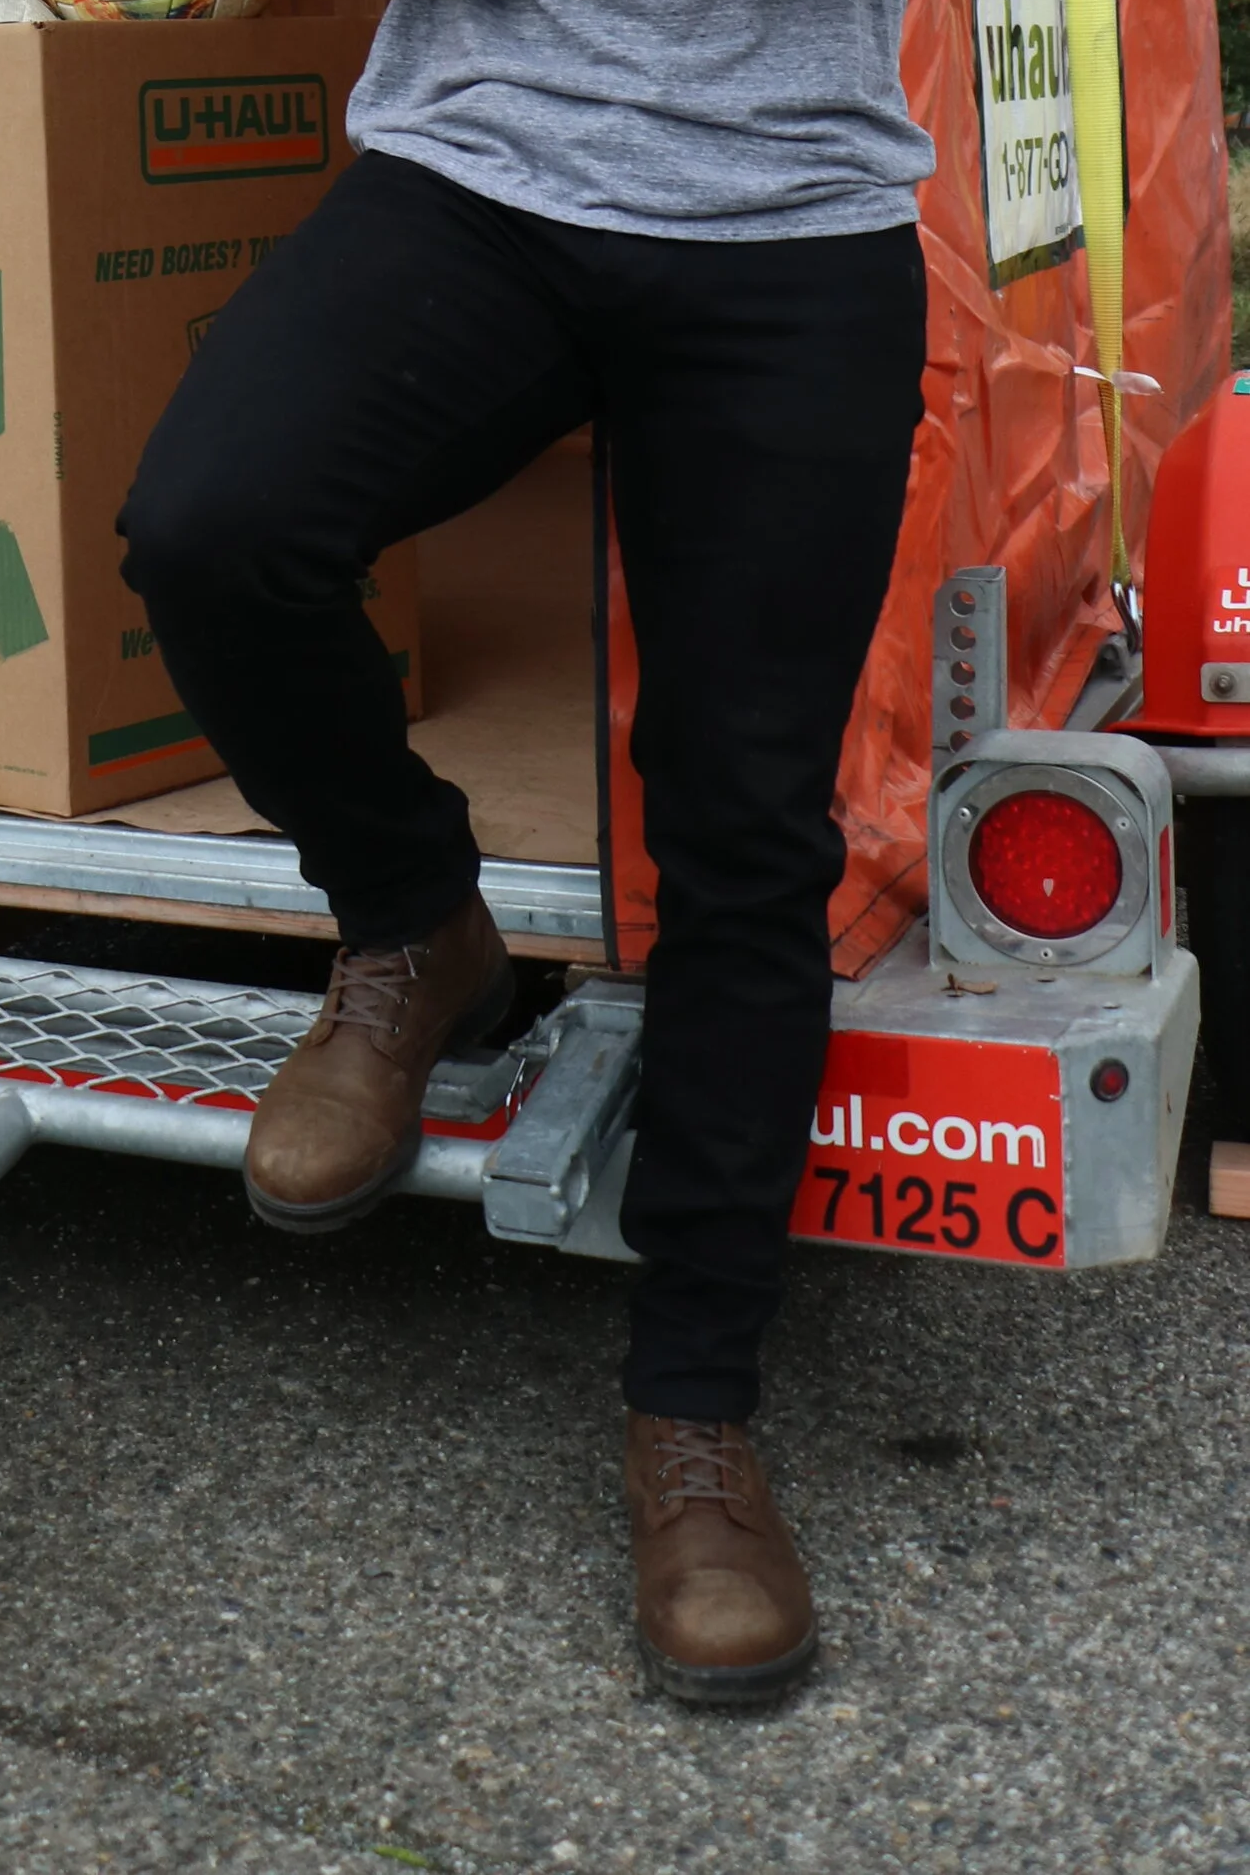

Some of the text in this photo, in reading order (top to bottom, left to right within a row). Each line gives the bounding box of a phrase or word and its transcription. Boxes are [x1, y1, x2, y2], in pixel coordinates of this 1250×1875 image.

[154, 91, 318, 142] U-HAUL
[1001, 130, 1069, 202] 1-877-GO
[95, 247, 155, 283] NEED
[161, 238, 242, 276] BOXES?
[1213, 616, 1250, 633] uh
[810, 1093, 1046, 1168] ul.com
[814, 1165, 1058, 1258] 7125 C
